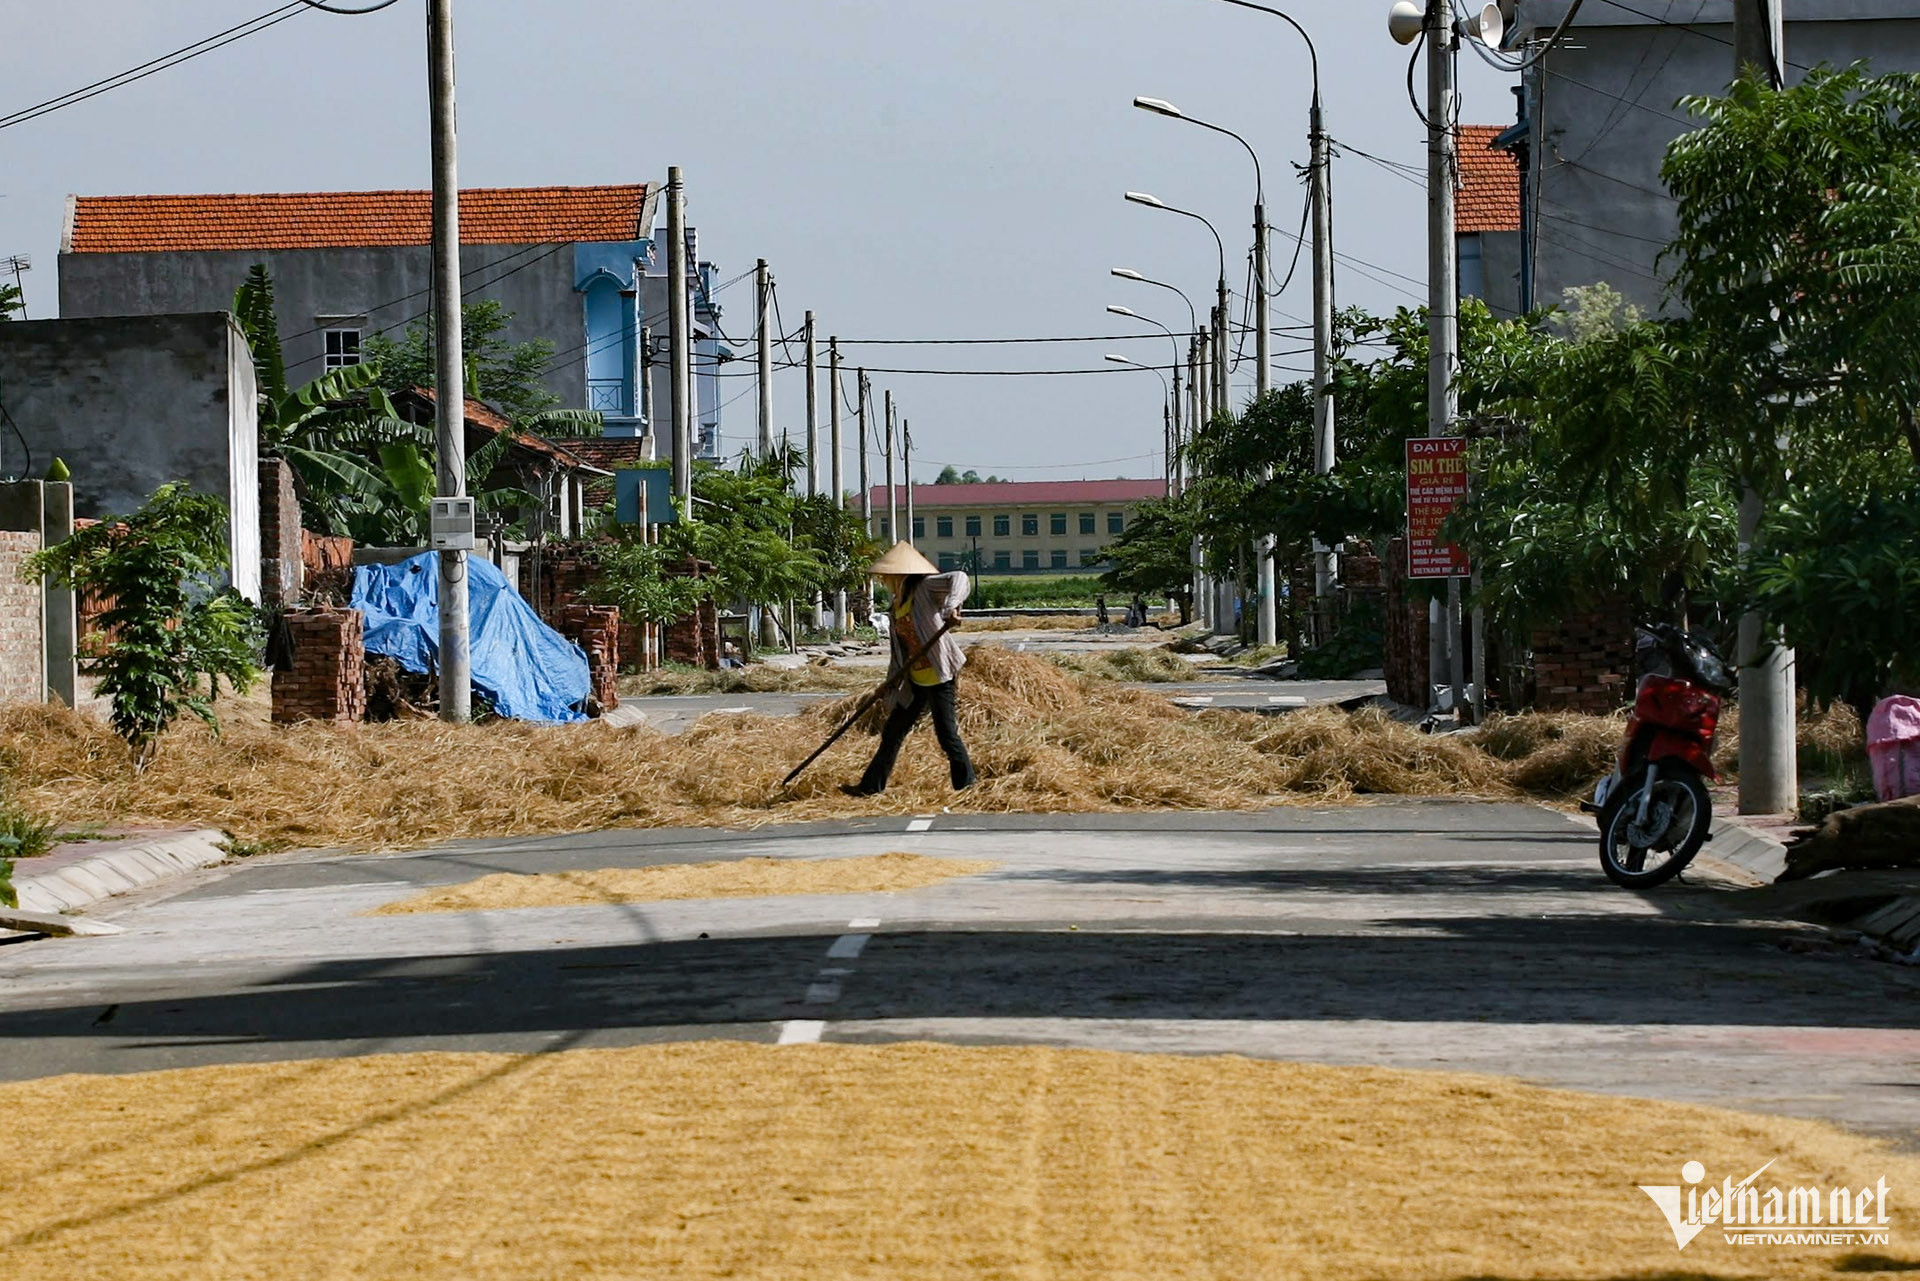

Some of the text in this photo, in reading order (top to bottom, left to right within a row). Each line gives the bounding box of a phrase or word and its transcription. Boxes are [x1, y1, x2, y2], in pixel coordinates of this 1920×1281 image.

[1443, 440, 1459, 451] LÝ
[1410, 458, 1433, 475] SIM
[1431, 507, 1443, 515] 50
[1412, 539, 1432, 547] VIETTE
